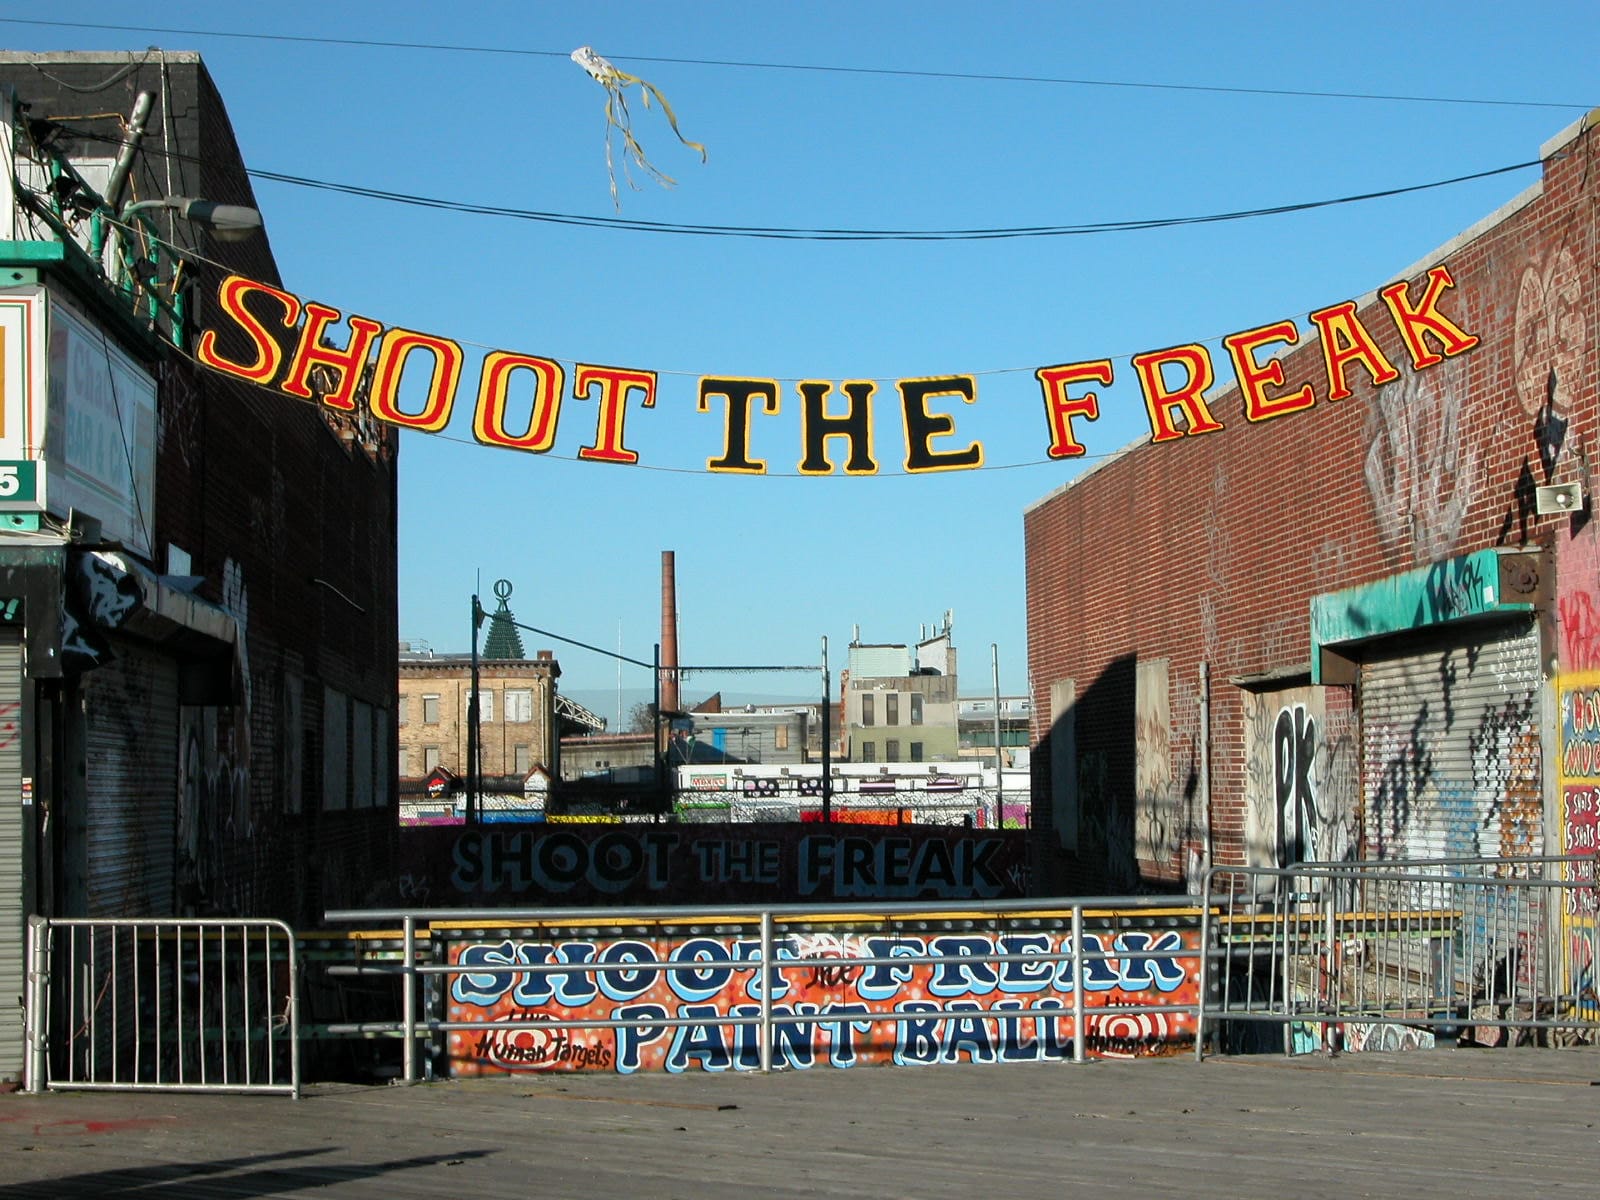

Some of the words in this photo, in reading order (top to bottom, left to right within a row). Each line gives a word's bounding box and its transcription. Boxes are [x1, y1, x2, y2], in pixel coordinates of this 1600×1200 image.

[196, 273, 657, 465] SHOOT
[697, 375, 984, 475] THE
[1036, 264, 1480, 460] FREAK
[450, 831, 680, 894] SHOOT
[693, 838, 781, 884] THE
[798, 835, 1006, 898] FREAK
[452, 938, 803, 1005] SHOOT
[856, 932, 1185, 999] FREAK
[475, 1033, 547, 1062] Human
[551, 1036, 612, 1070] Targets
[611, 1002, 872, 1073] PAINT
[893, 998, 1080, 1066] BALL
